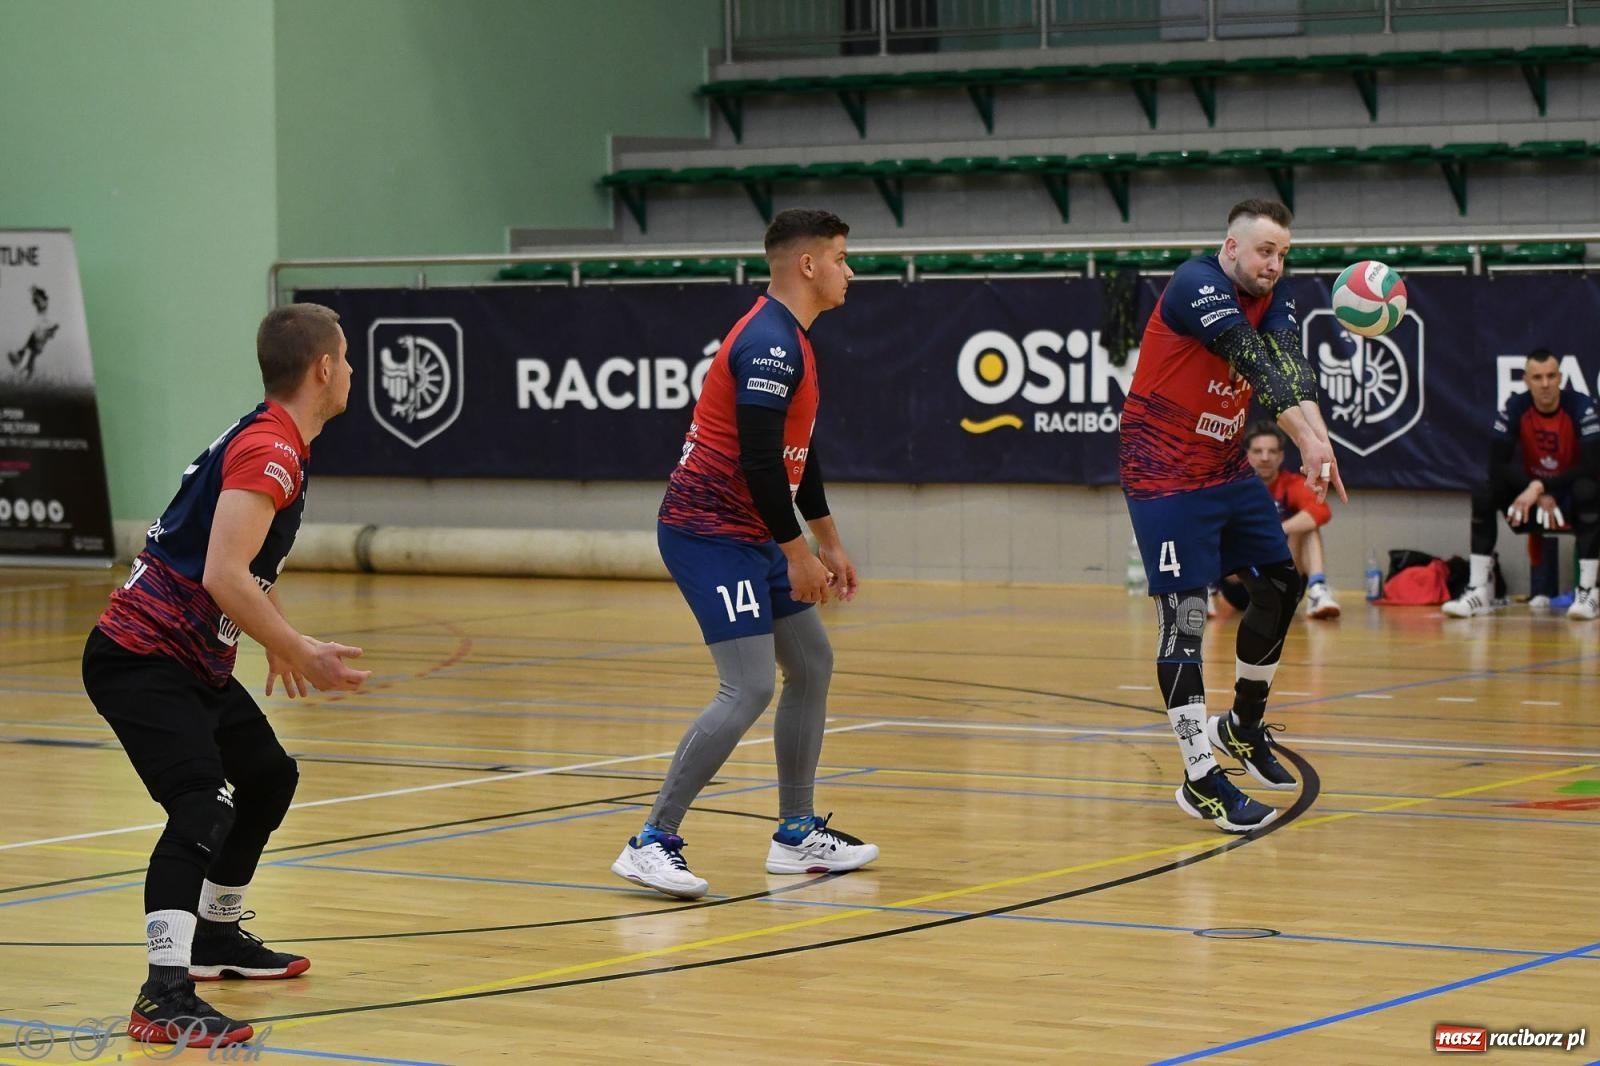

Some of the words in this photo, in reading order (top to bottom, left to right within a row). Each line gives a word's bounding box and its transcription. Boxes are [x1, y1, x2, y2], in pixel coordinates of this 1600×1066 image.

[1191, 293, 1231, 308] KATOLIK
[752, 357, 794, 375] KATOLIK
[748, 379, 788, 397] nowiny.pl
[1497, 355, 1600, 412] RA
[1034, 405, 1120, 433] RACIBÓ
[1159, 540, 1181, 578] 4
[716, 579, 760, 623] 14
